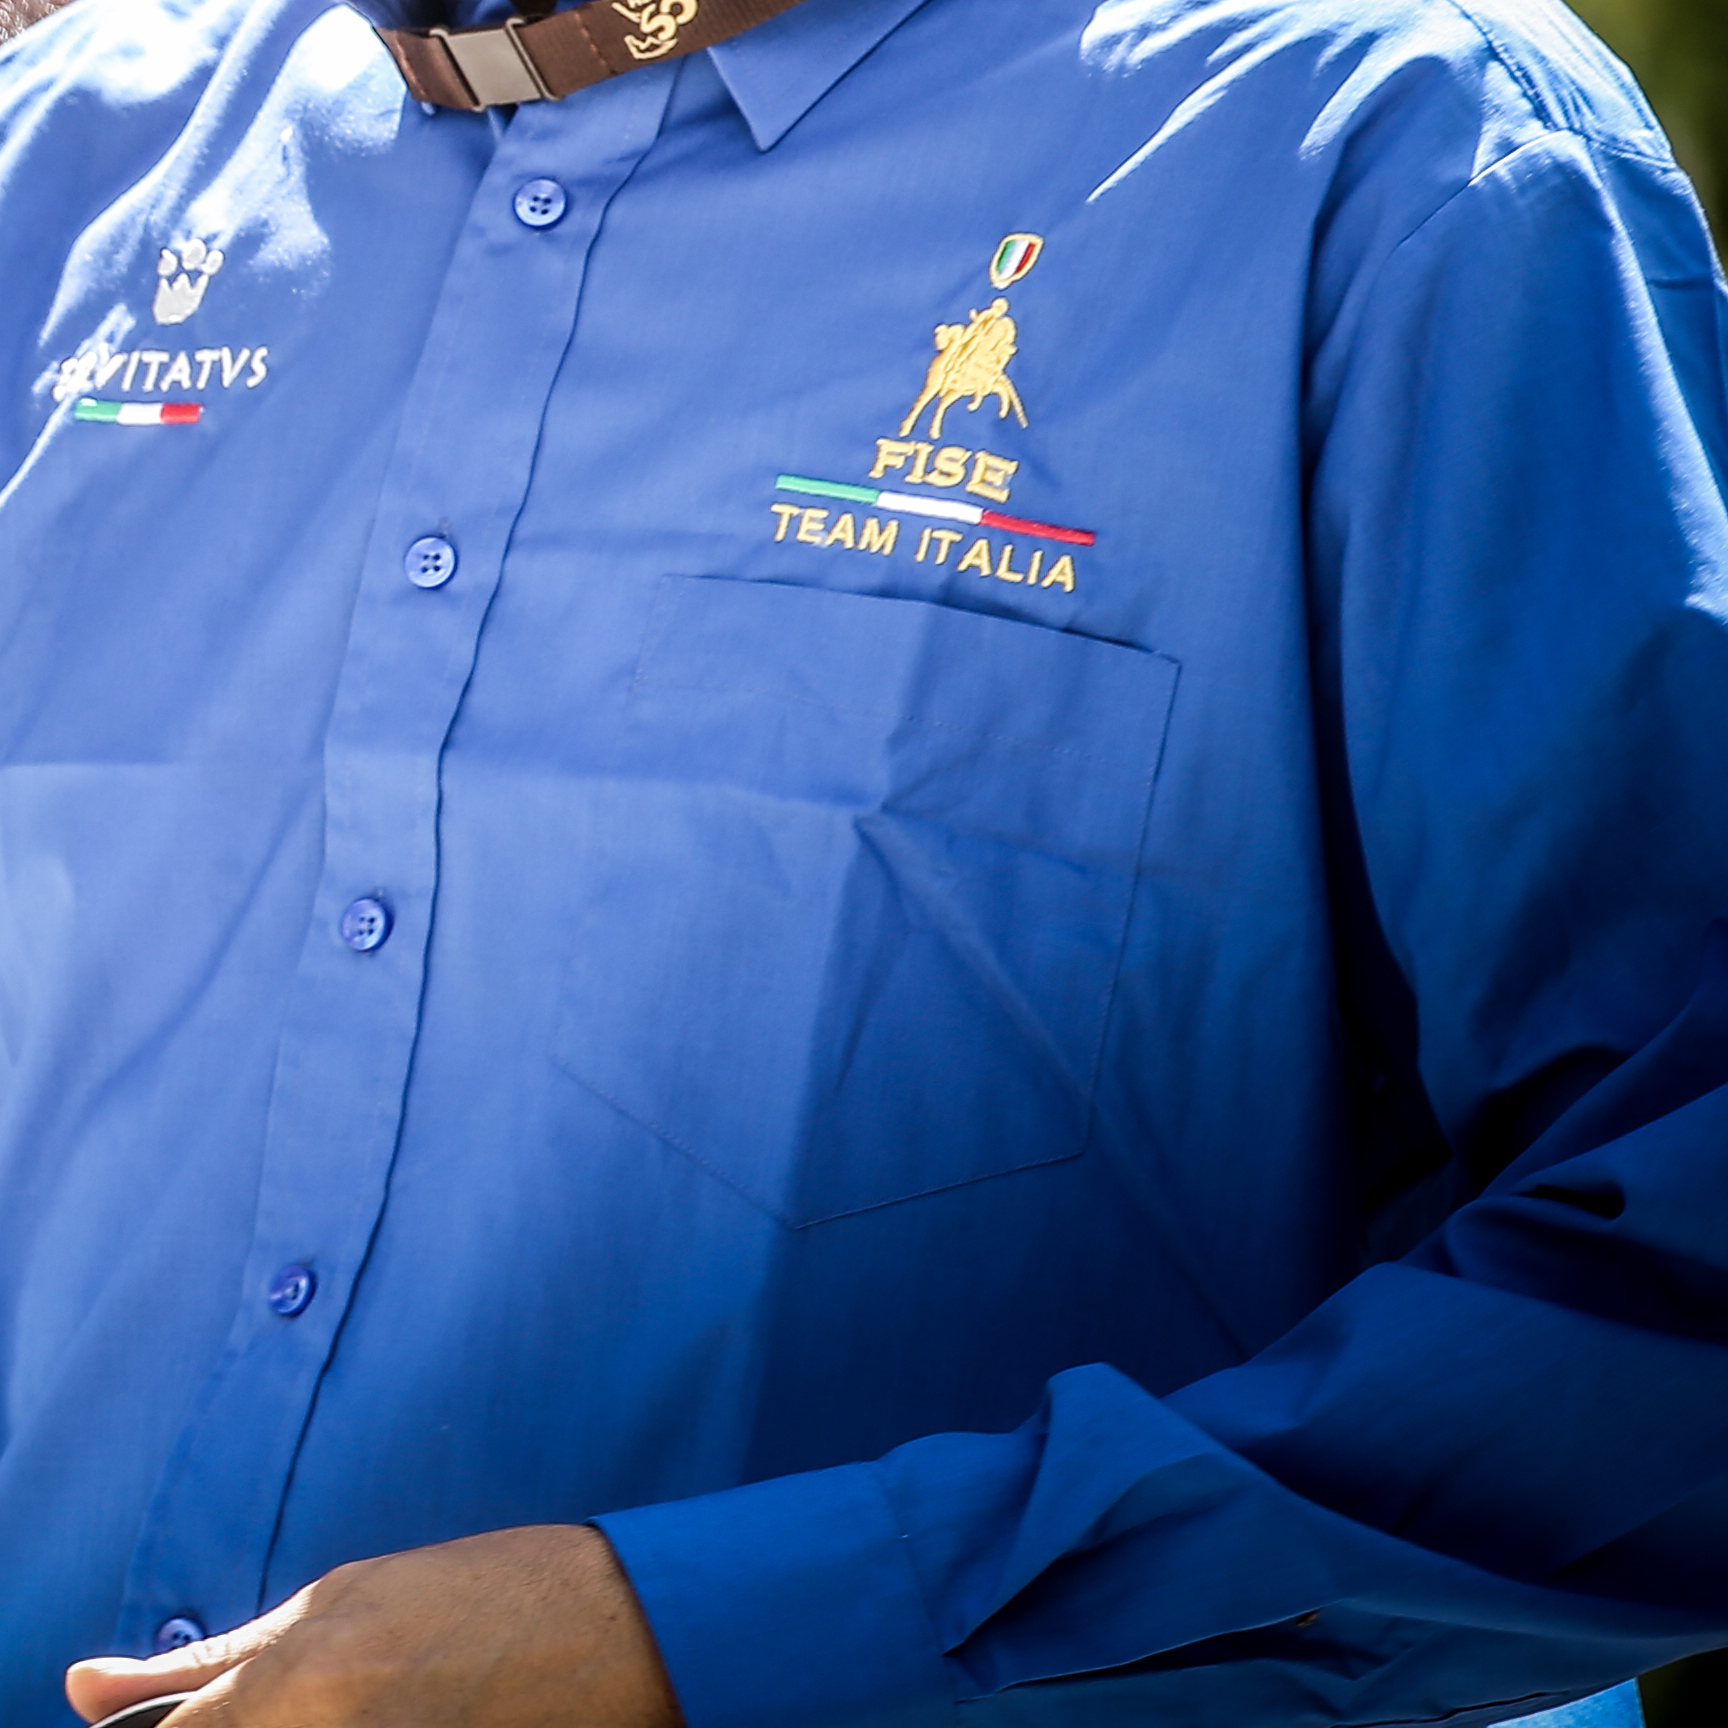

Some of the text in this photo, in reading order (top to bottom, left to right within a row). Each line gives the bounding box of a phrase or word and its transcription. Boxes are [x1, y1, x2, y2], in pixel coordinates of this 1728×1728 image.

[868, 437, 1020, 503] FISE
[770, 502, 1077, 593] TEAM ITALIA
